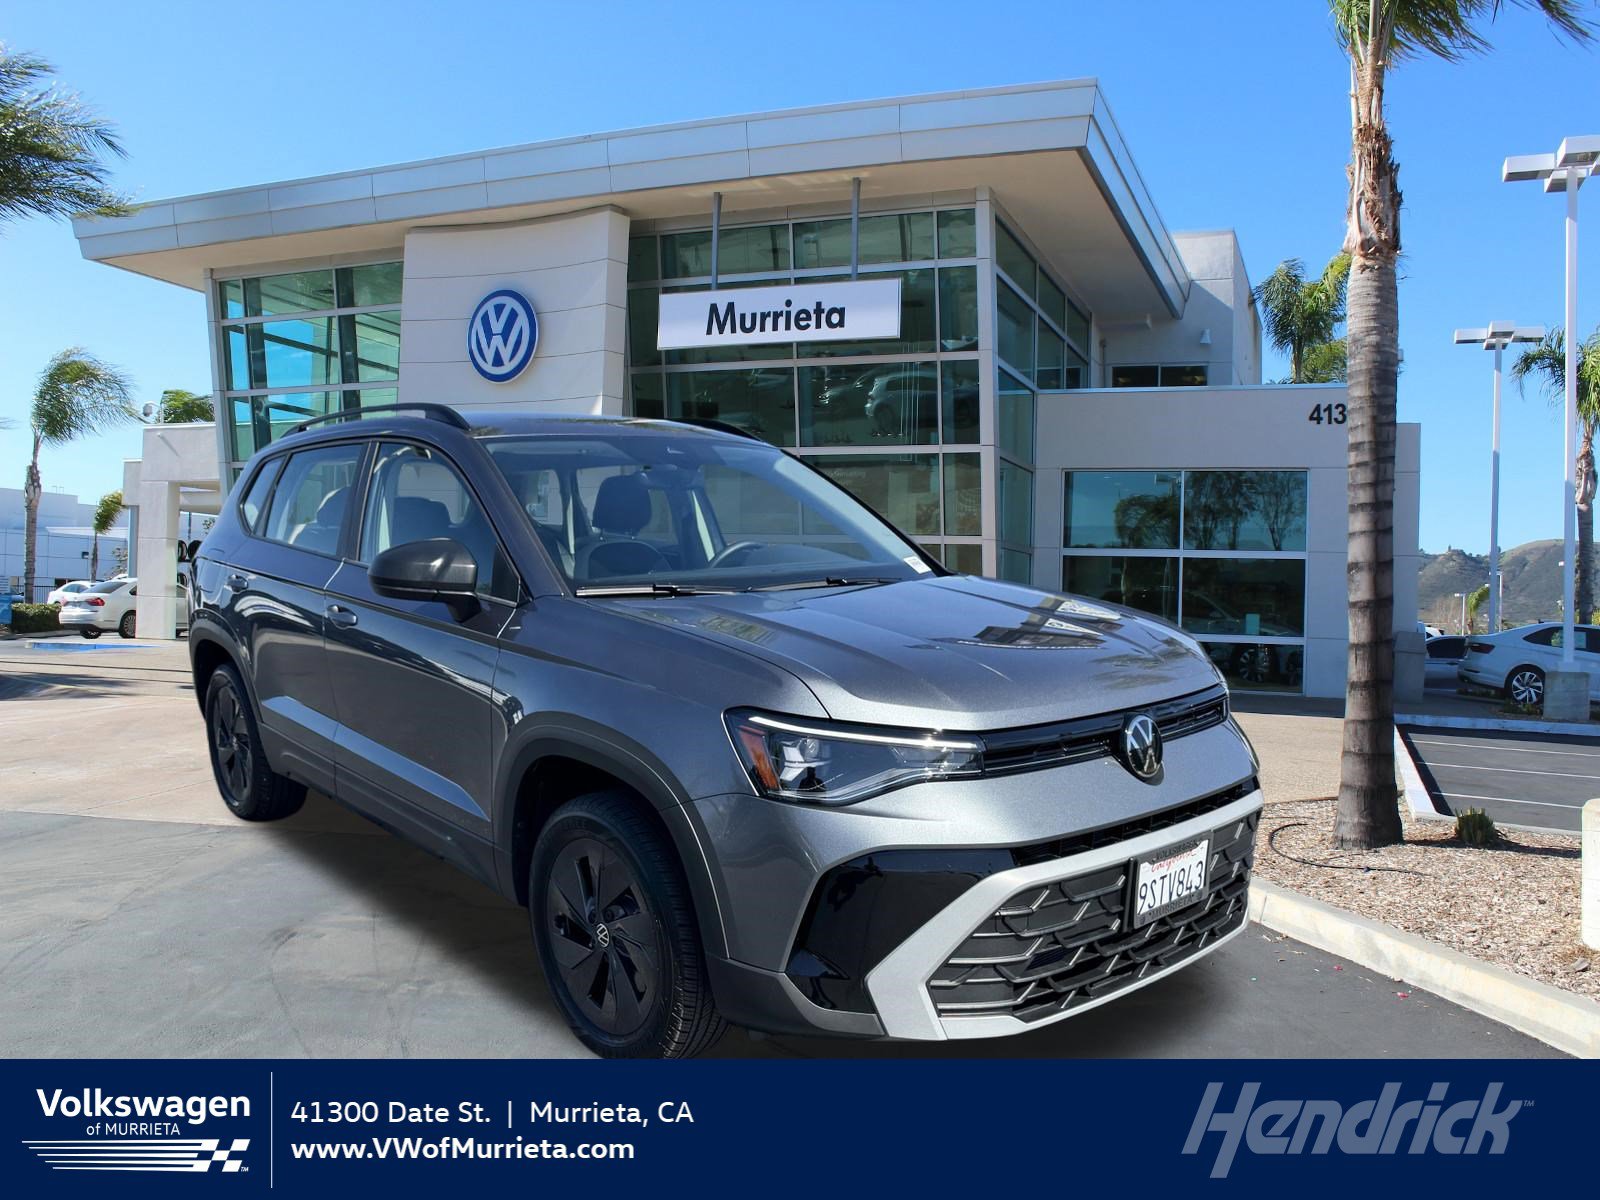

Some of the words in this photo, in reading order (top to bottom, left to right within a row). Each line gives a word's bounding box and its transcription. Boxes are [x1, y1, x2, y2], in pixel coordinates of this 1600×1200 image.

[706, 299, 846, 335] Murrieta
[1308, 403, 1347, 425] 413
[1136, 860, 1204, 916] 9STV843
